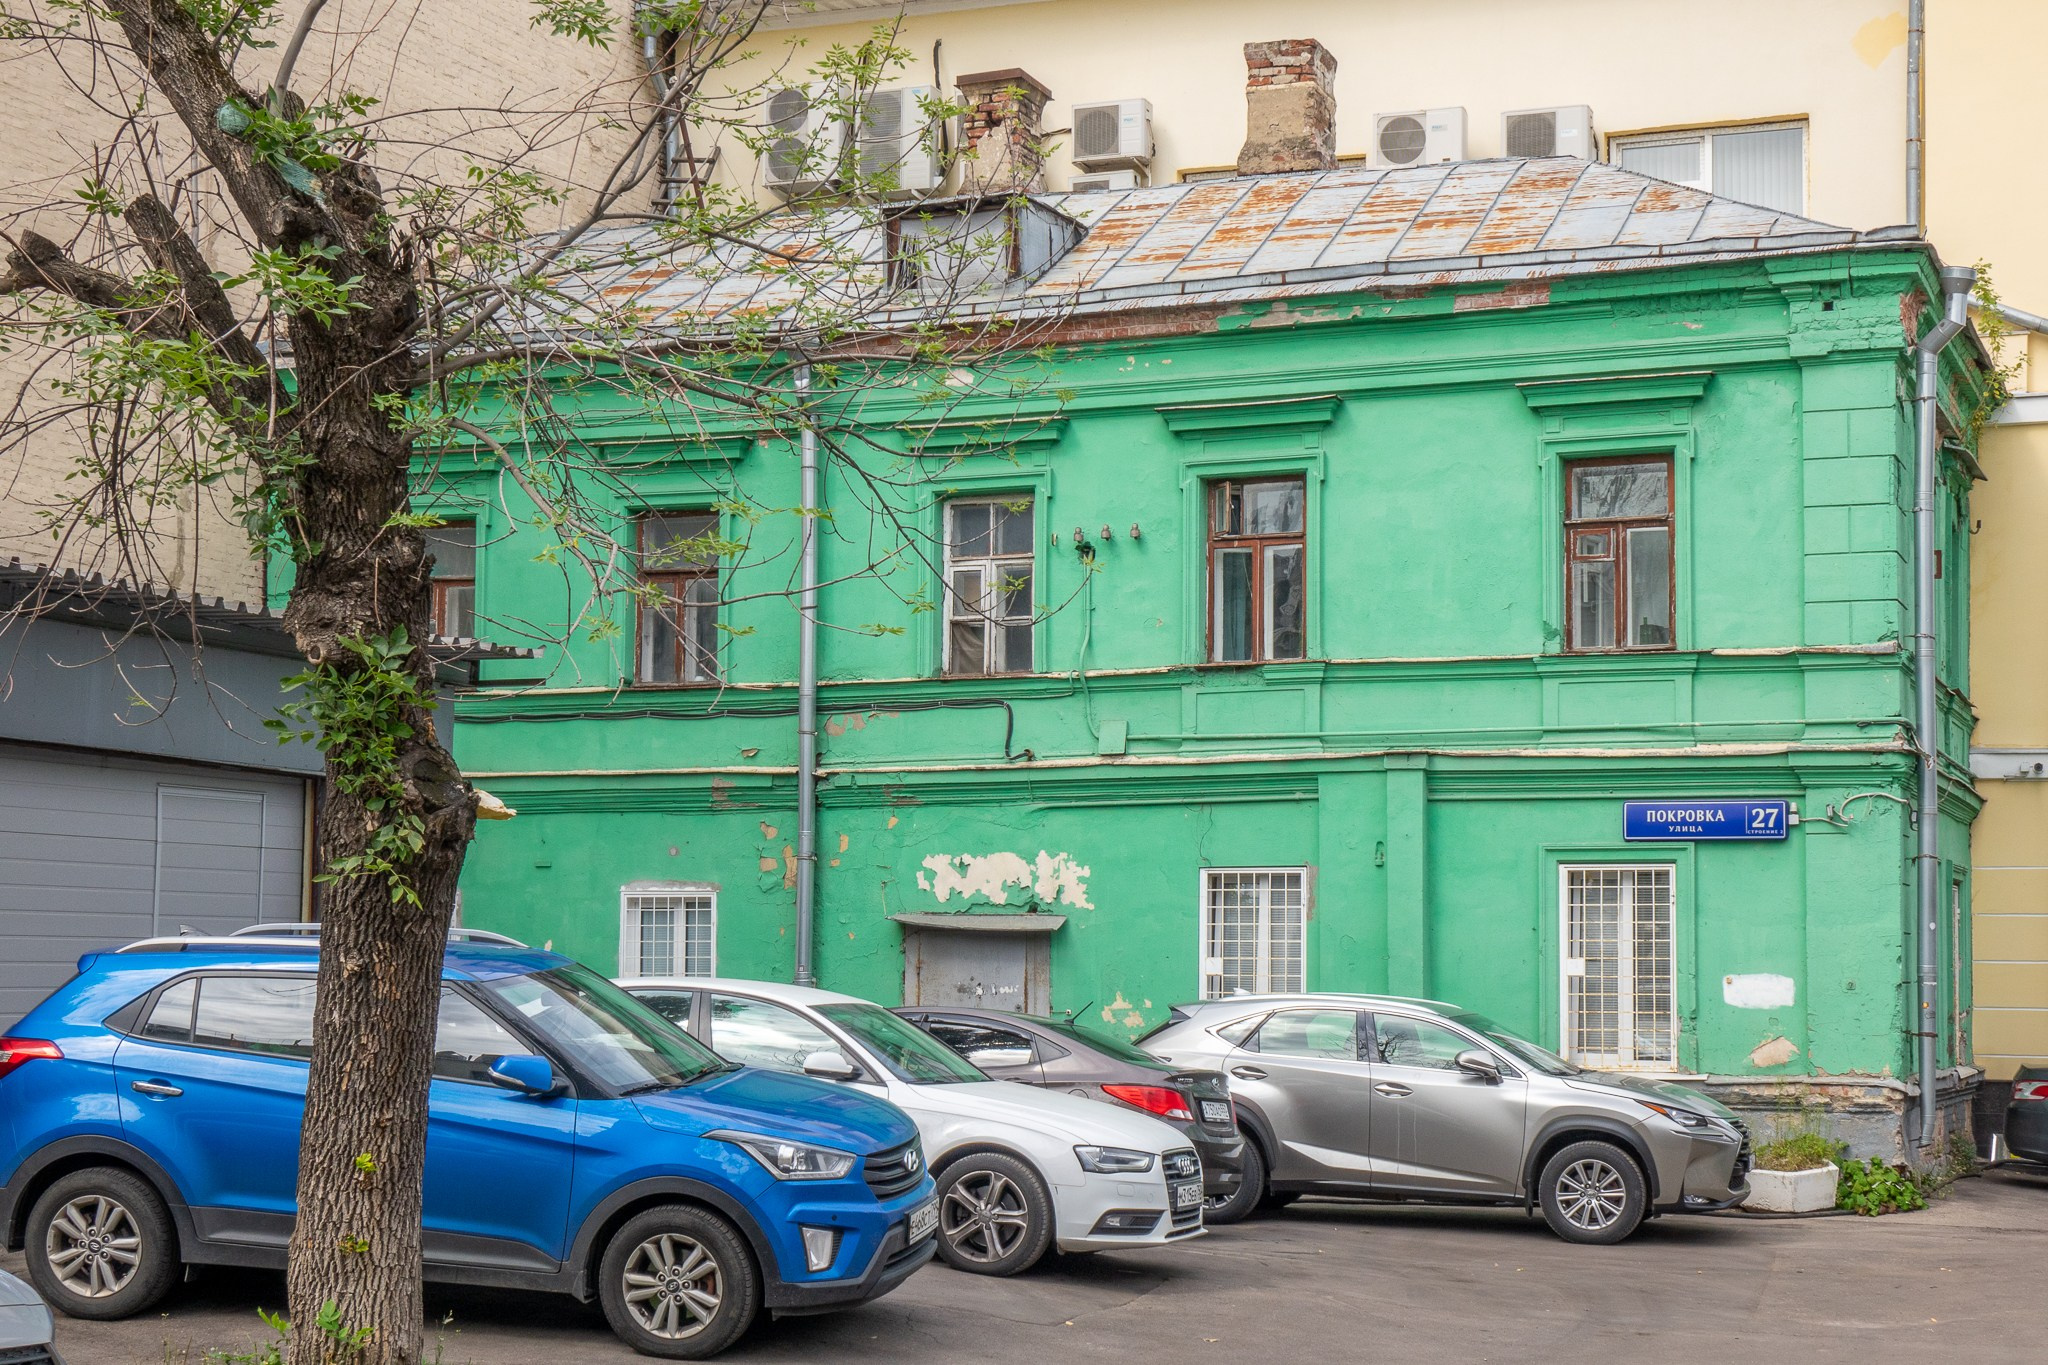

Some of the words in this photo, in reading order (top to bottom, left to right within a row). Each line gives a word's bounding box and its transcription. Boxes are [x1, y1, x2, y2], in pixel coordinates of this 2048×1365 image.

[1646, 809, 1725, 822] ПОКРОВКА
[1751, 808, 1779, 828] 27
[1668, 825, 1703, 833] УЛИЦА
